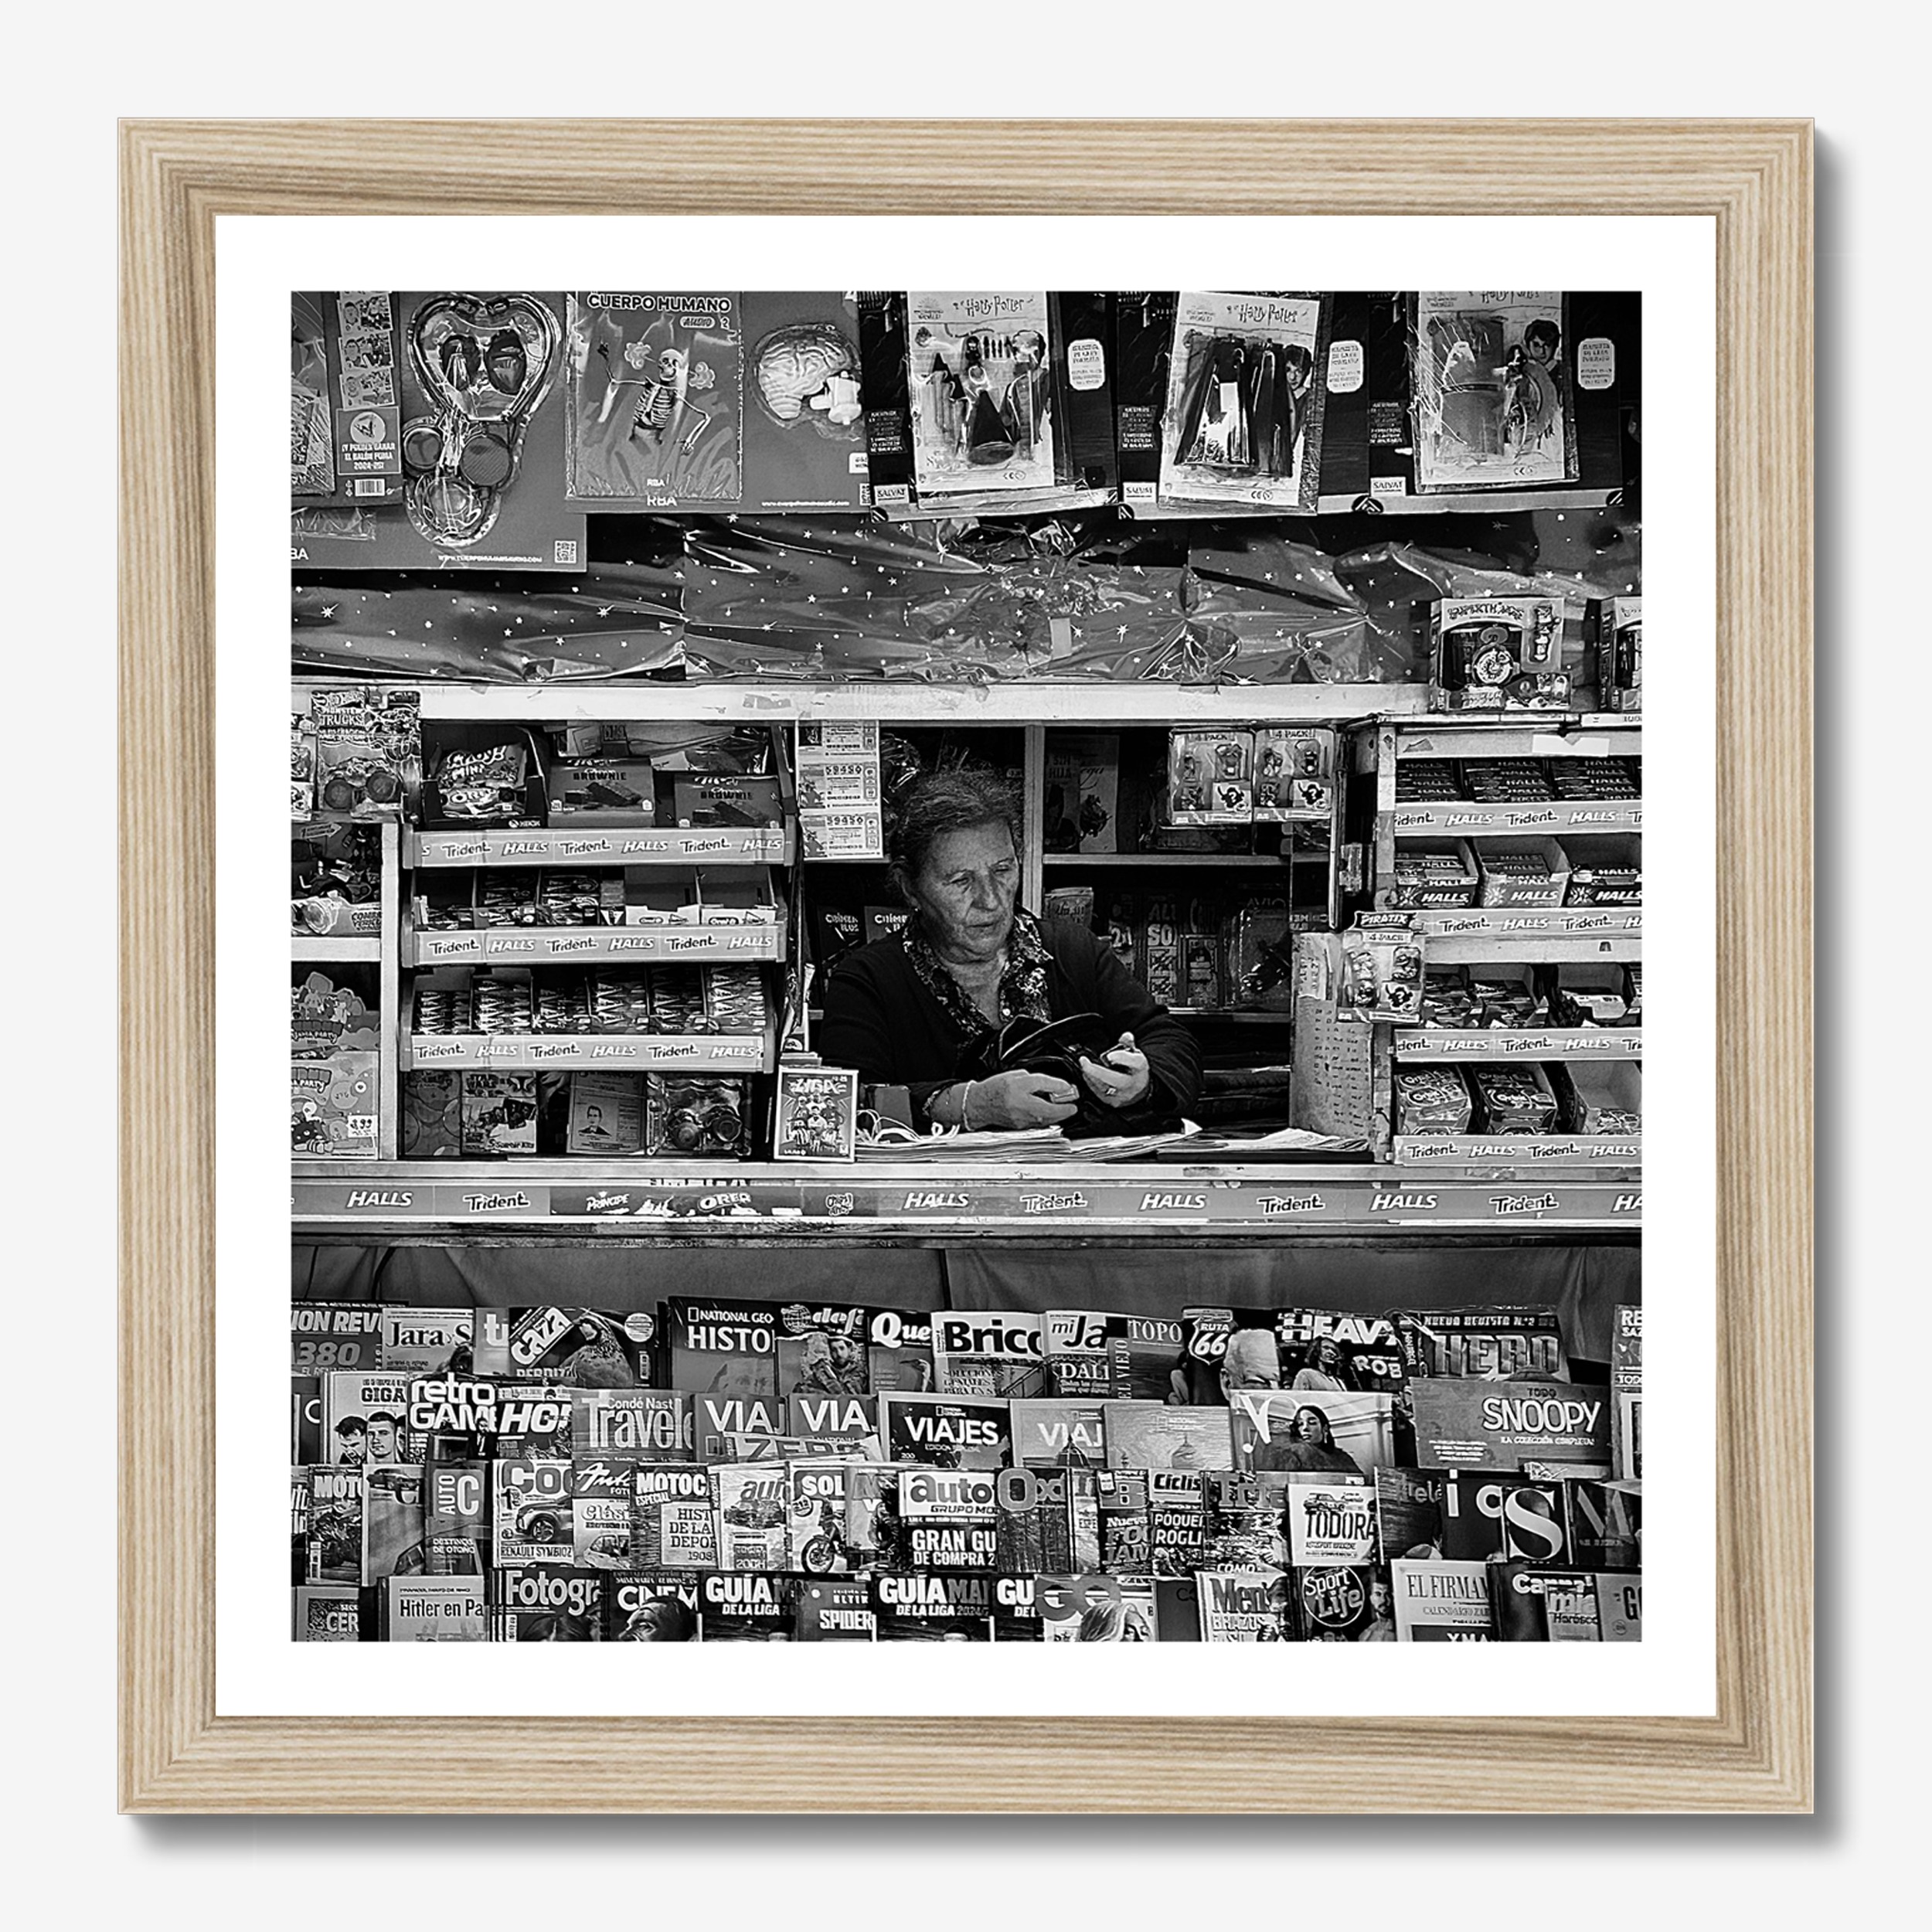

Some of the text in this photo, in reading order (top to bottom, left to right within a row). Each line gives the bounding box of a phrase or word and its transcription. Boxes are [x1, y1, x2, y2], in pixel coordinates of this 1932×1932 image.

[587, 293, 731, 313] CUERPO HUMANO
[647, 495, 678, 506] RBA
[321, 714, 362, 726] TRUCKS
[1445, 813, 1494, 828] HALLS
[1504, 809, 1559, 827] Trident
[1568, 811, 1617, 825] HALLS
[442, 836, 783, 859] Trident HALLS Trident HALLS Trident HALLS
[1598, 867, 1638, 876] HALLS
[1421, 891, 1469, 903] HALLS
[1510, 889, 1559, 901] HALLS
[1595, 889, 1641, 902] HALLS
[1360, 913, 1408, 925] PIRATIX
[1440, 916, 1491, 934] Trident
[1501, 917, 1549, 932] HALLS
[1561, 913, 1614, 932] Trident
[427, 934, 774, 956] Trident HALLS Trident HALLS Trident HALLS
[413, 1041, 757, 1060] Trident HALLS Trident HALLS Trident HALLS
[1441, 1035, 1611, 1053] HALLS Trident HALLS
[1406, 1141, 1638, 1158] Trident HALLS Trident HALLS
[346, 1189, 413, 1209] HALLS
[463, 1191, 530, 1212] Trident
[902, 1192, 970, 1211] HALLS
[1019, 1191, 1088, 1213] Trident
[1138, 1193, 1207, 1212] HALLS
[1257, 1194, 1325, 1215] Trident
[1369, 1194, 1439, 1213] HALLS
[1488, 1192, 1560, 1215] Trident
[1611, 1194, 1641, 1213] HA
[332, 1311, 382, 1334] REV
[699, 1309, 750, 1322] NATIONAL
[386, 1321, 444, 1349] Jara
[871, 1311, 932, 1349] Que
[1128, 1318, 1183, 1343] TOPO
[1200, 1322, 1230, 1332] RUTA
[688, 1325, 775, 1353] HISTO
[1195, 1332, 1229, 1356] 66
[1353, 1355, 1403, 1379] ROB
[361, 1387, 408, 1403] GIGA
[410, 1372, 495, 1405] retro
[1527, 1387, 1557, 1398] TODO
[608, 1396, 674, 1410] Condé Nast
[704, 1400, 786, 1435] VIAJ
[798, 1400, 879, 1433] VIA
[1482, 1396, 1602, 1434] SNOOPY
[904, 1416, 999, 1446] VIAJES
[437, 1475, 480, 1516] AUTO C
[910, 1474, 993, 1504] auto
[677, 1508, 711, 1520] HIST
[930, 1505, 974, 1514] GRUPO
[669, 1522, 711, 1534] DE LA
[1504, 1487, 1564, 1561] S
[911, 1529, 997, 1553] GRAN GU
[913, 1552, 995, 1566] DE COMPRA 2
[705, 1573, 774, 1604] GUÍA
[879, 1573, 947, 1605] GUÍA
[996, 1578, 1035, 1606] GU
[1304, 1566, 1350, 1597] Sport
[1406, 1574, 1428, 1598] EL
[400, 1598, 485, 1617] Hitler en Pa
[1315, 1577, 1363, 1618] Life
[722, 1604, 781, 1616] DE LA LIGA
[819, 1609, 873, 1631] SPIDER
[896, 1605, 955, 1617] DE LA LIGA
[1014, 1606, 1030, 1617] DE
[325, 1611, 359, 1633] CER
